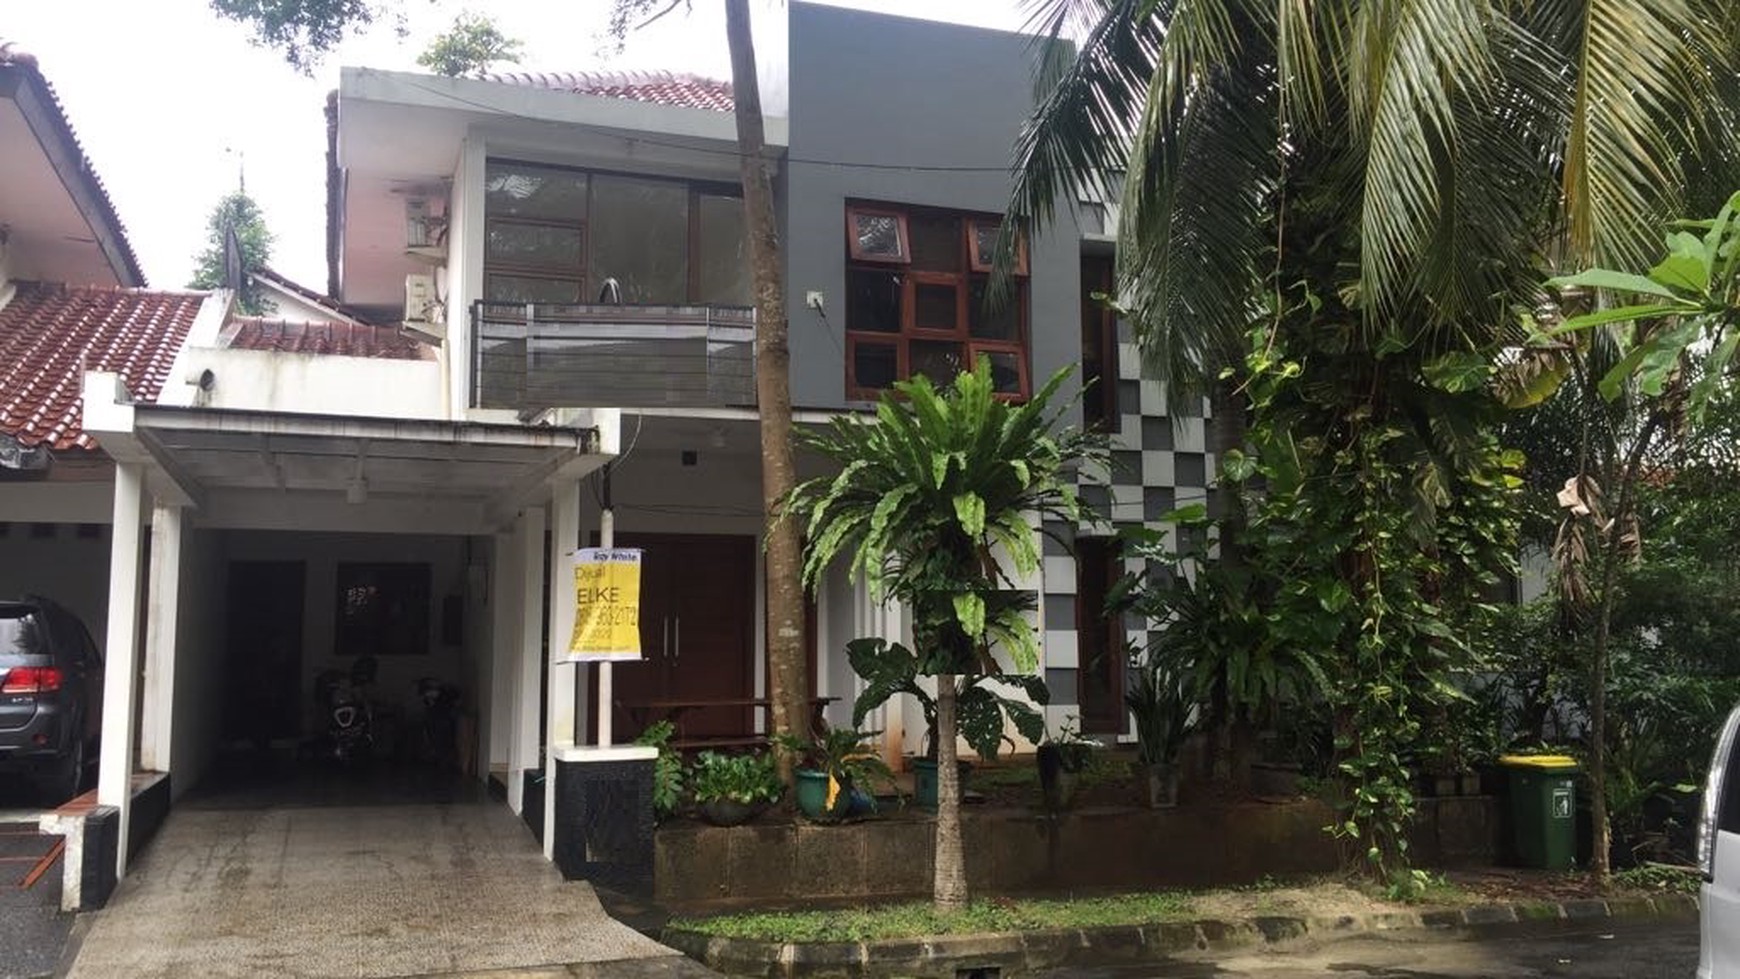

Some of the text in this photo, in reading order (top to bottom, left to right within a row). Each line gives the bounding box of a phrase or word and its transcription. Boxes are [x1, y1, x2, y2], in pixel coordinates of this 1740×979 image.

[611, 551, 637, 562] White
[575, 565, 606, 581] Dijual
[577, 587, 620, 604] ELKE
